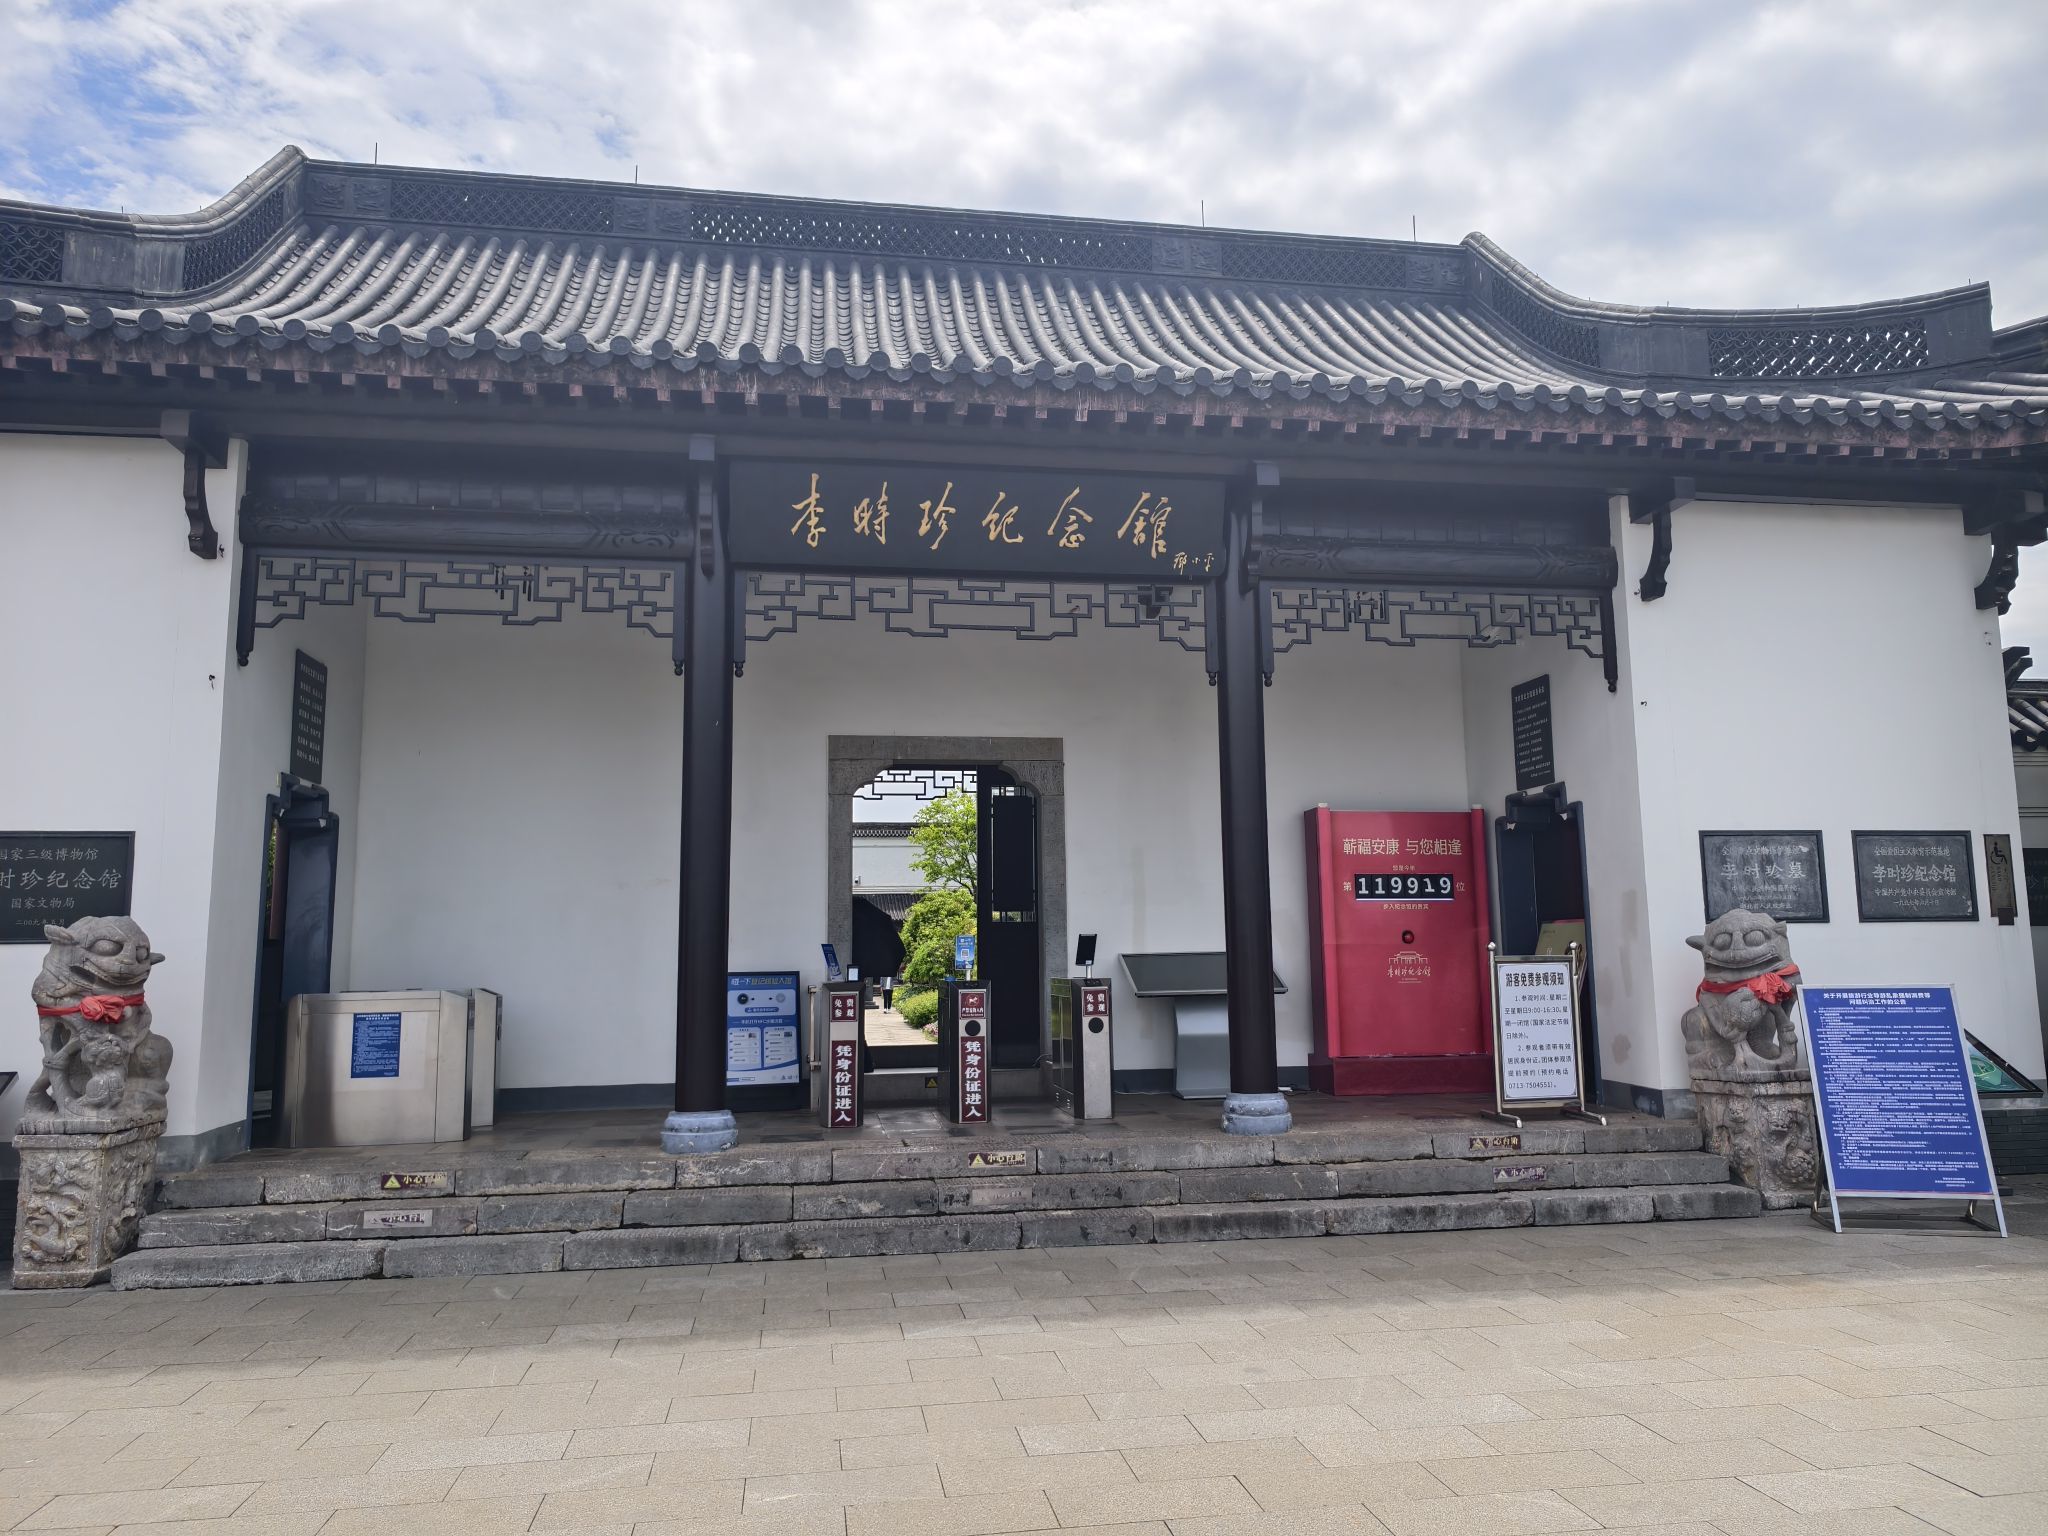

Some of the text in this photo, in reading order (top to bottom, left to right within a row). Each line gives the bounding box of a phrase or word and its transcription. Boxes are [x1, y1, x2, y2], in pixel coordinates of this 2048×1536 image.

[1343, 838, 1463, 855] 蕲福安康 与您相逢
[1720, 860, 1806, 880] 李时珍墓
[1872, 863, 1957, 883] 李时珍纪念馆
[1343, 877, 1465, 895] 第 119919 位
[11, 897, 75, 909] 国家文物局
[1505, 972, 1564, 987] 游客免费参观须知
[835, 1045, 853, 1123] 凭身份证进入
[965, 1041, 982, 1118] 凭身份证进入
